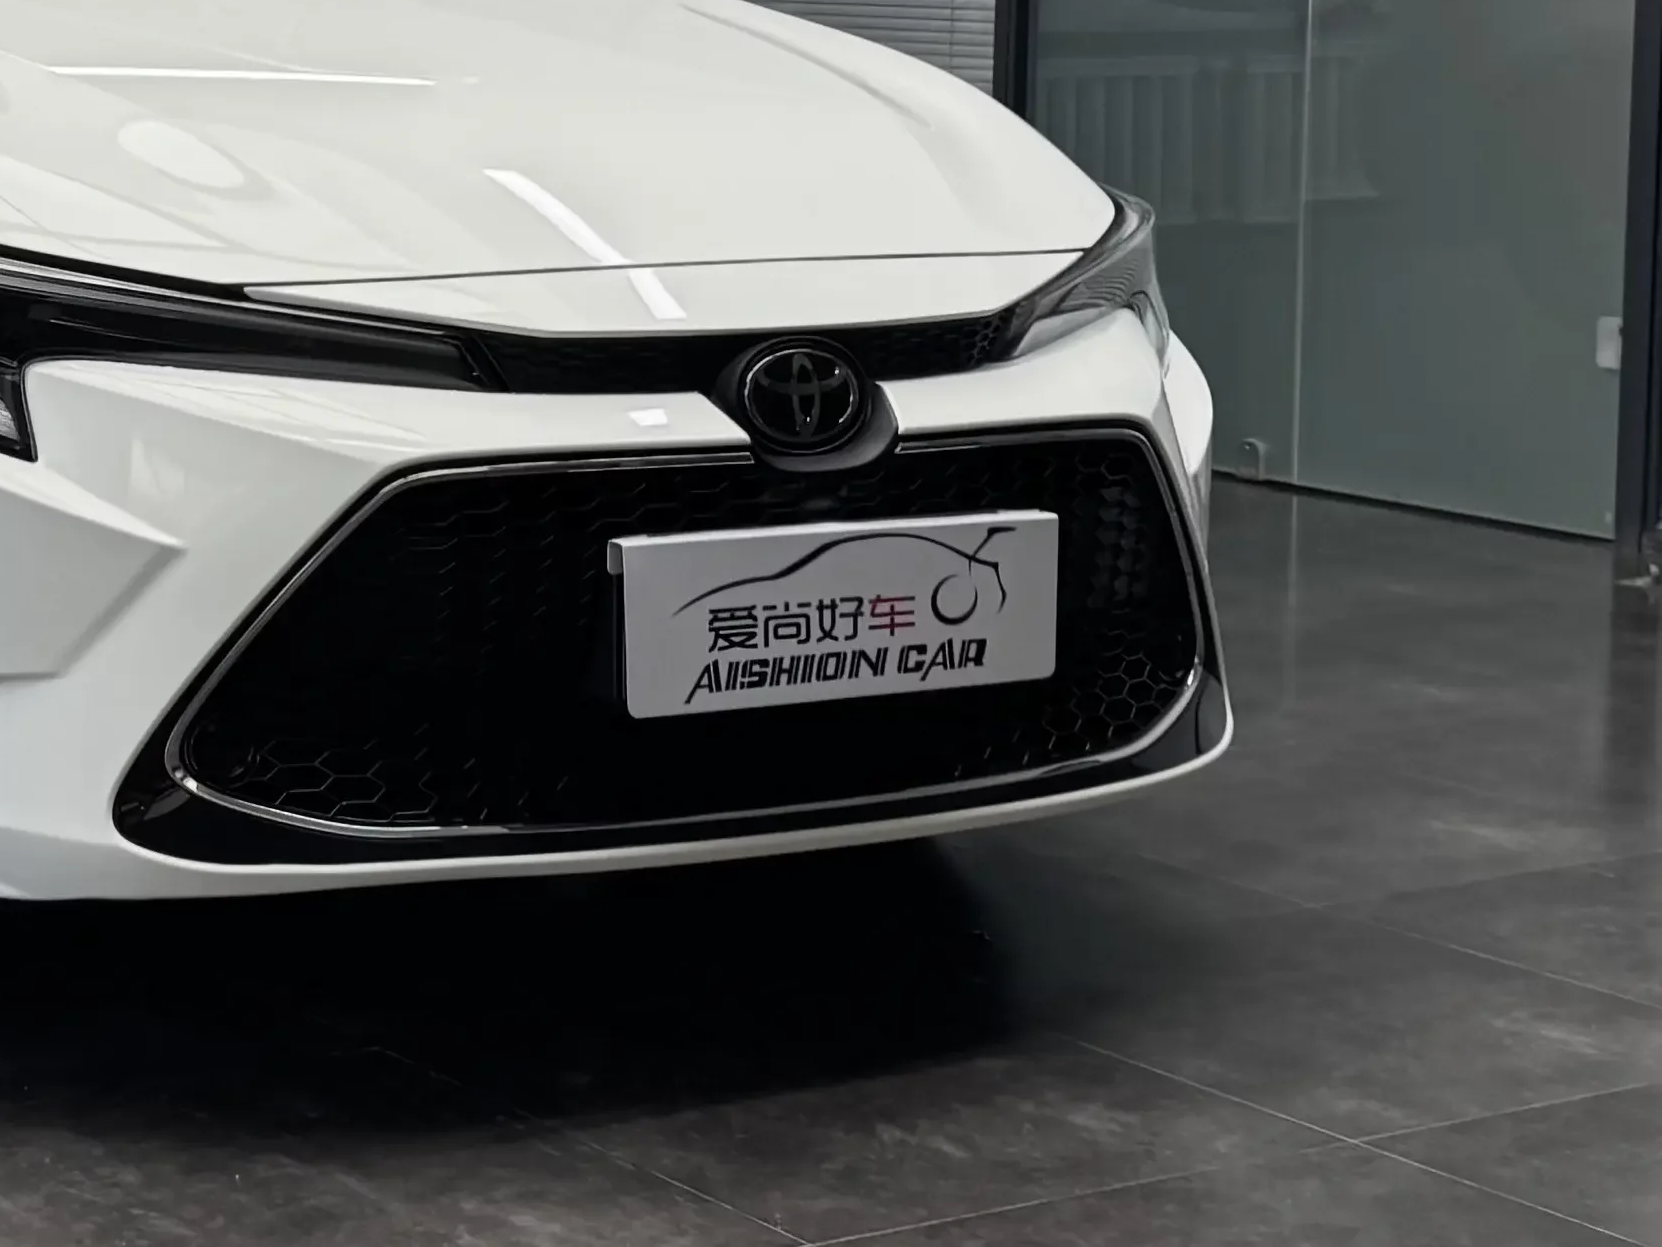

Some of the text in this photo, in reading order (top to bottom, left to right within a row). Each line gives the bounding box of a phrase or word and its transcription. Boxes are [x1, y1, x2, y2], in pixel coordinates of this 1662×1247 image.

[708, 595, 916, 653] 爱尚好车
[684, 638, 988, 705] AISHION CAR
